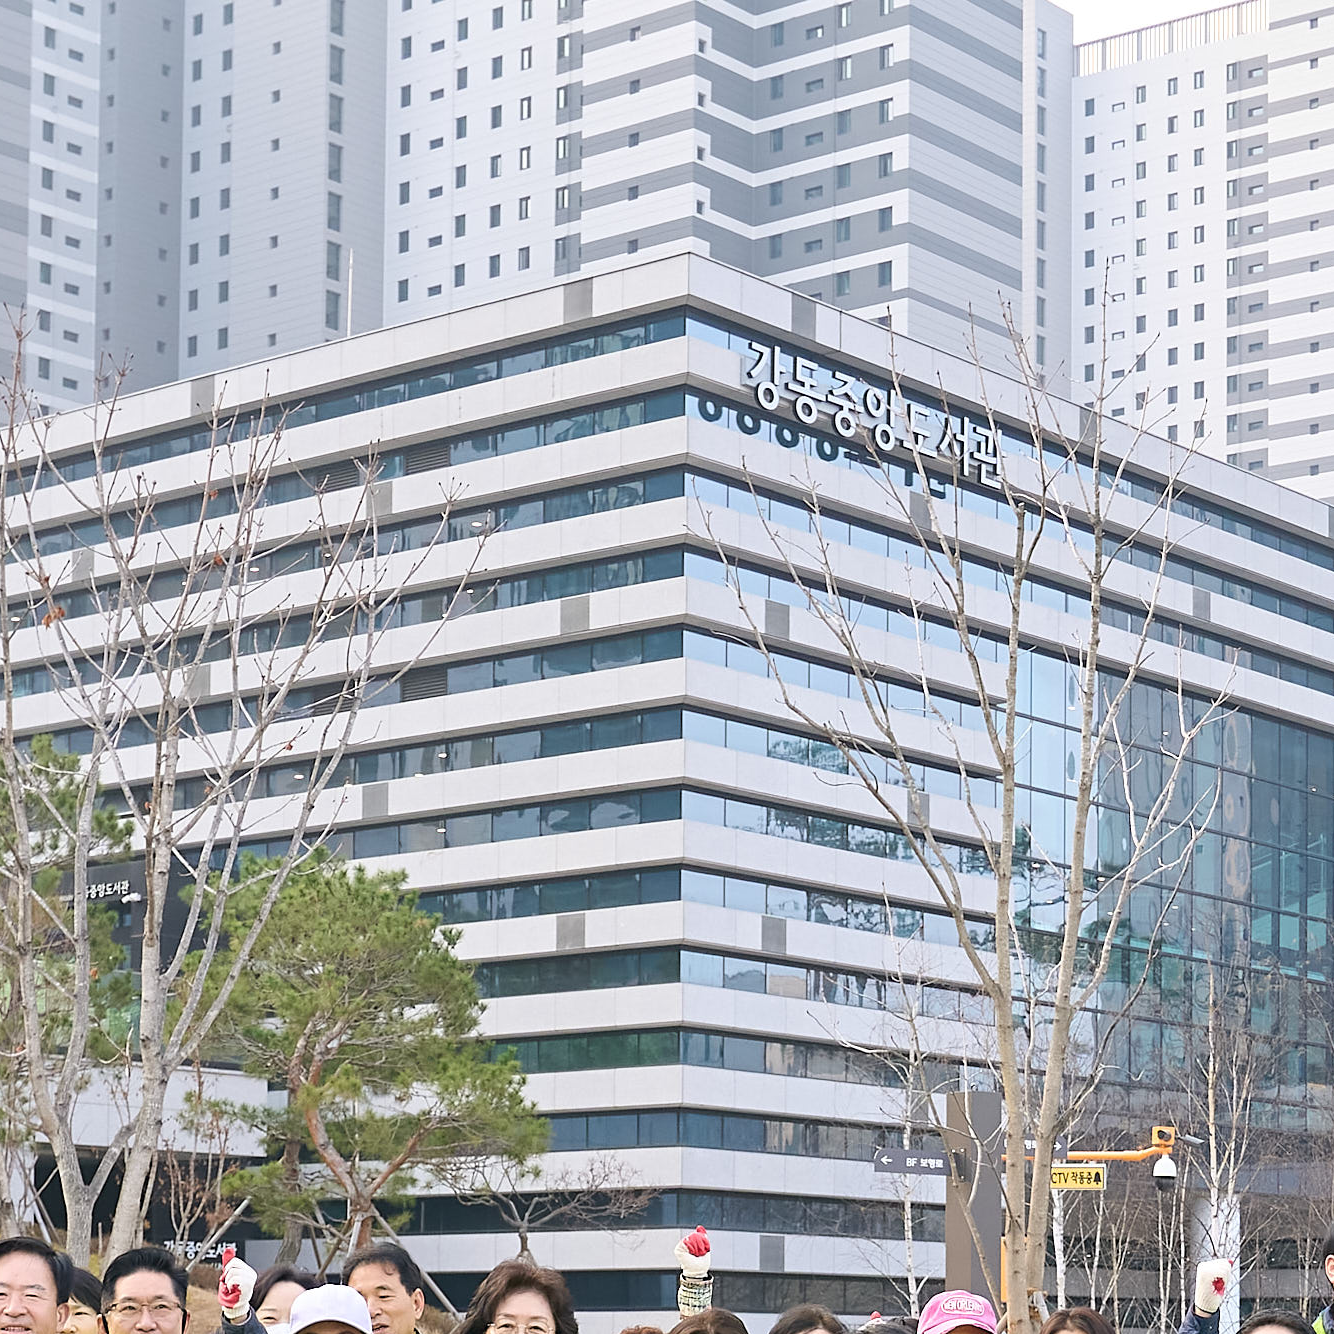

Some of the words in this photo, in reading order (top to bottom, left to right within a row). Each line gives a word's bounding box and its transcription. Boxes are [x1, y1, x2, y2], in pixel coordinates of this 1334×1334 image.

[746, 342, 1003, 489] 강동중앙도서관
[1051, 1172, 1069, 1184] CTV
[1071, 1172, 1092, 1184] 작동중
